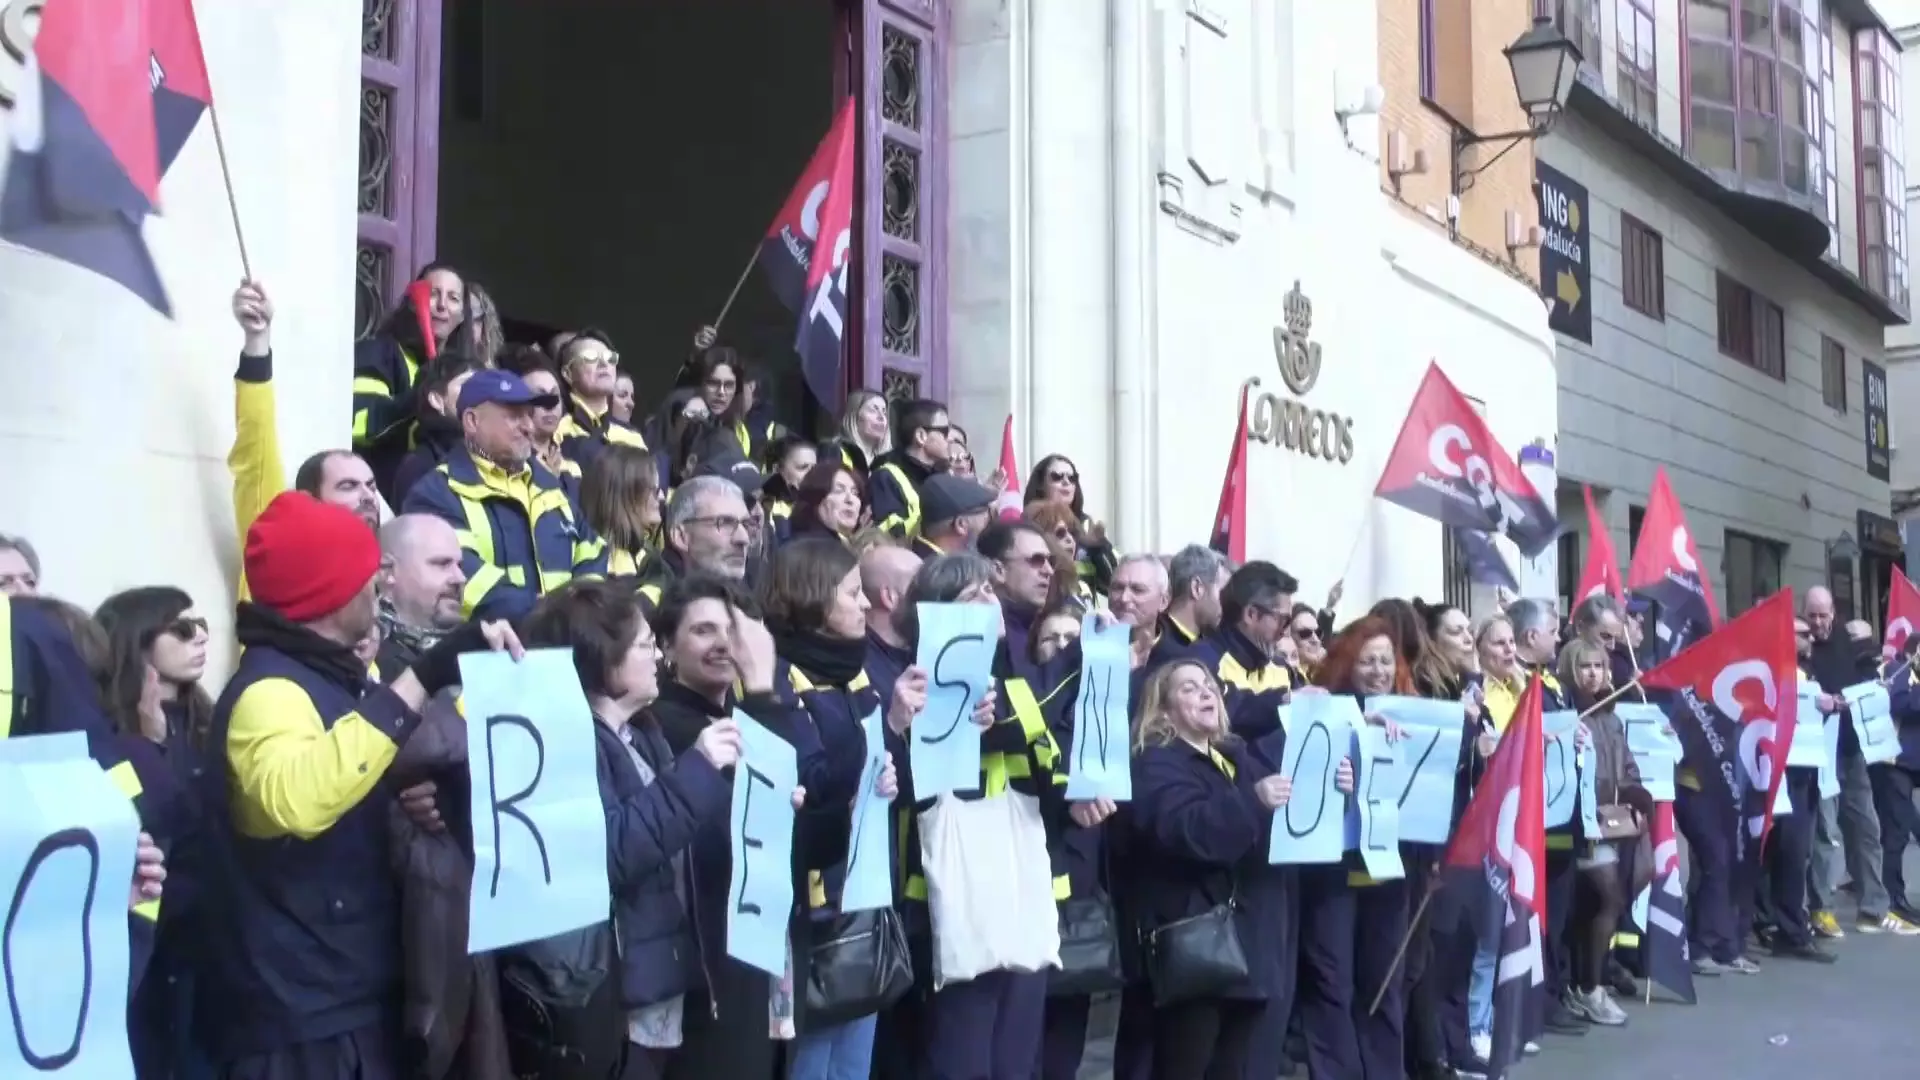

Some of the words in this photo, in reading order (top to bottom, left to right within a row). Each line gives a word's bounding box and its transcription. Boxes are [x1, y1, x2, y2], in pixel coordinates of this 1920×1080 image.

[1237, 376, 1354, 466] CORREOS
[920, 633, 984, 744] S
[1079, 664, 1112, 772] N
[486, 714, 551, 898] R
[1285, 719, 1331, 838] O
[1366, 755, 1394, 851] E
[737, 762, 775, 914] E
[3, 827, 99, 1072] O
